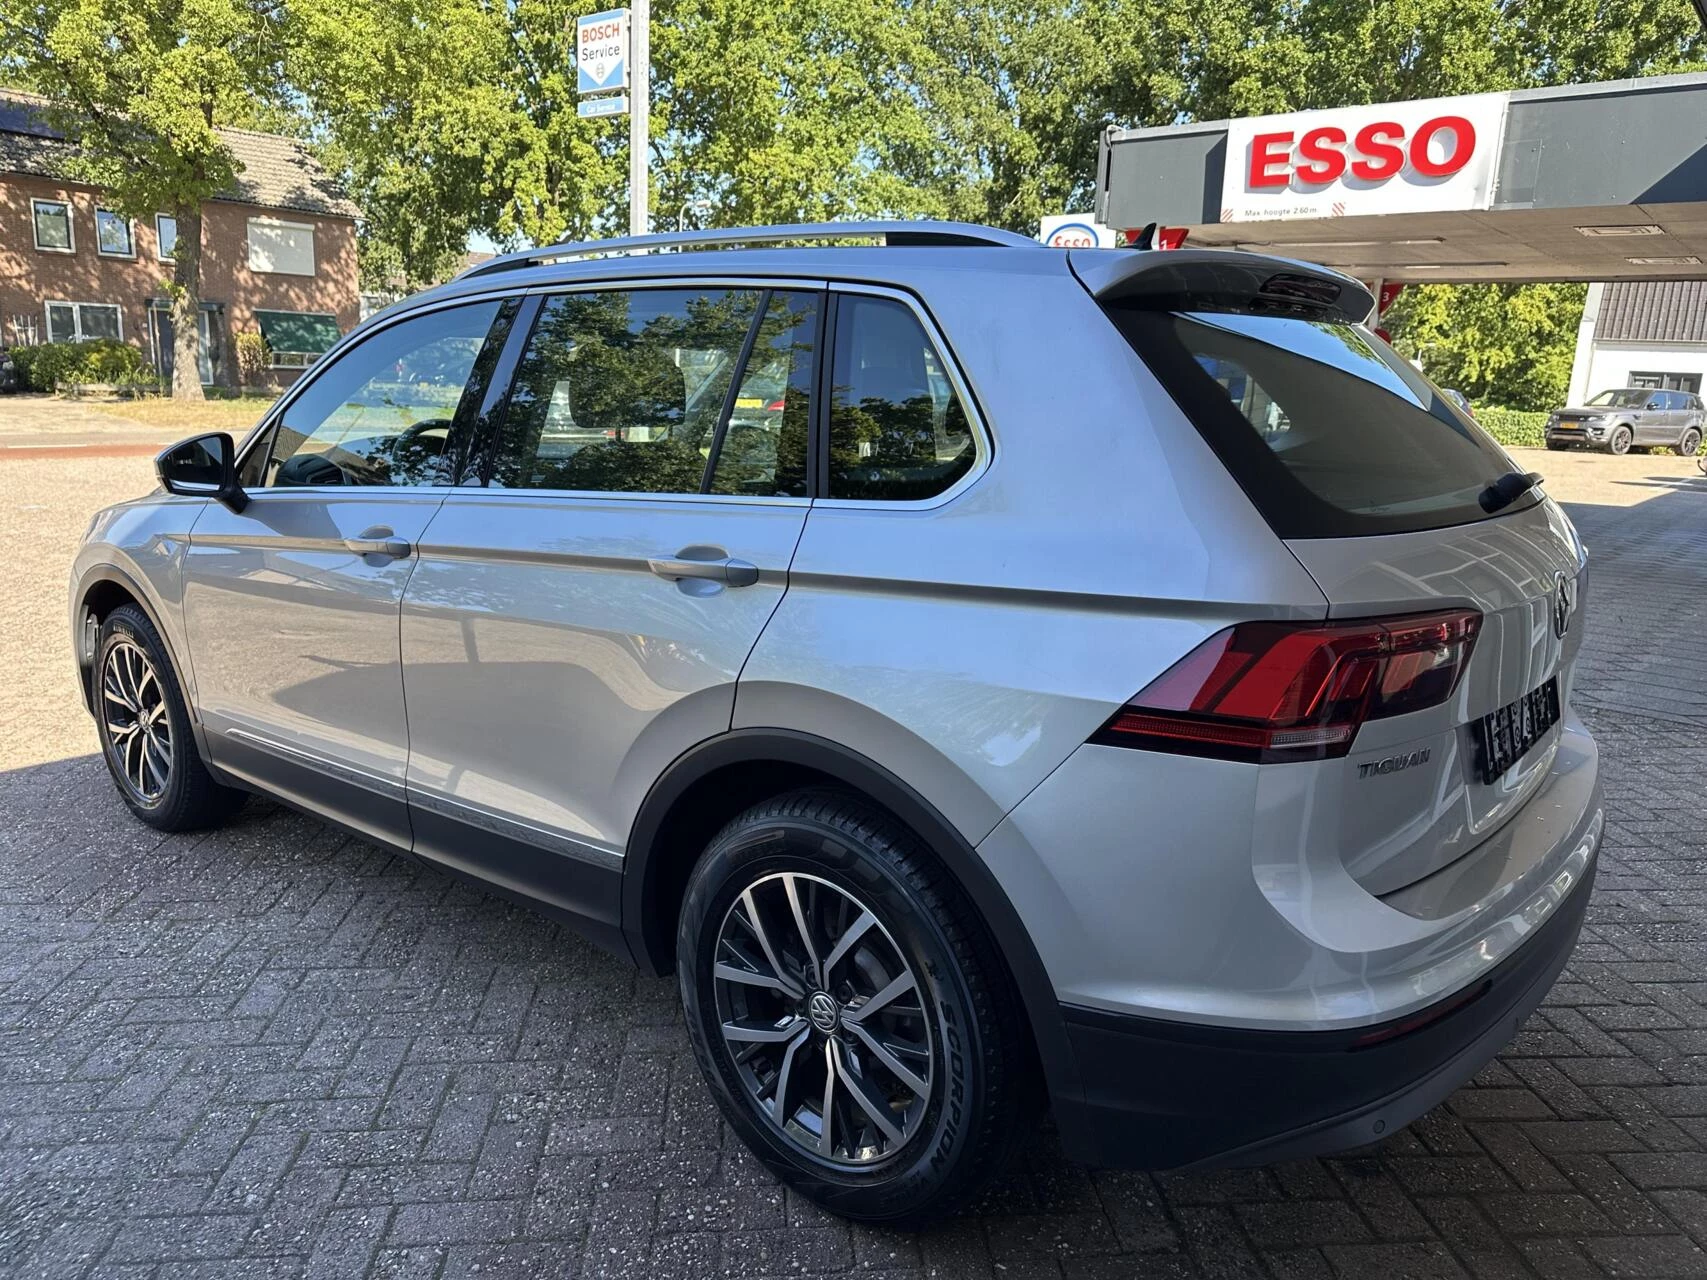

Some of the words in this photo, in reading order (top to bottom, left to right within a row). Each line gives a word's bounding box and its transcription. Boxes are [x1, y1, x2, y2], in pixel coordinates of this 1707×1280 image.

[582, 22, 620, 44] BOSCH
[582, 44, 620, 61] Service
[1249, 116, 1476, 187] ESSO
[1382, 291, 1390, 302] 3
[1357, 747, 1431, 779] TIGUAN
[929, 1000, 965, 1173] SCORPION
